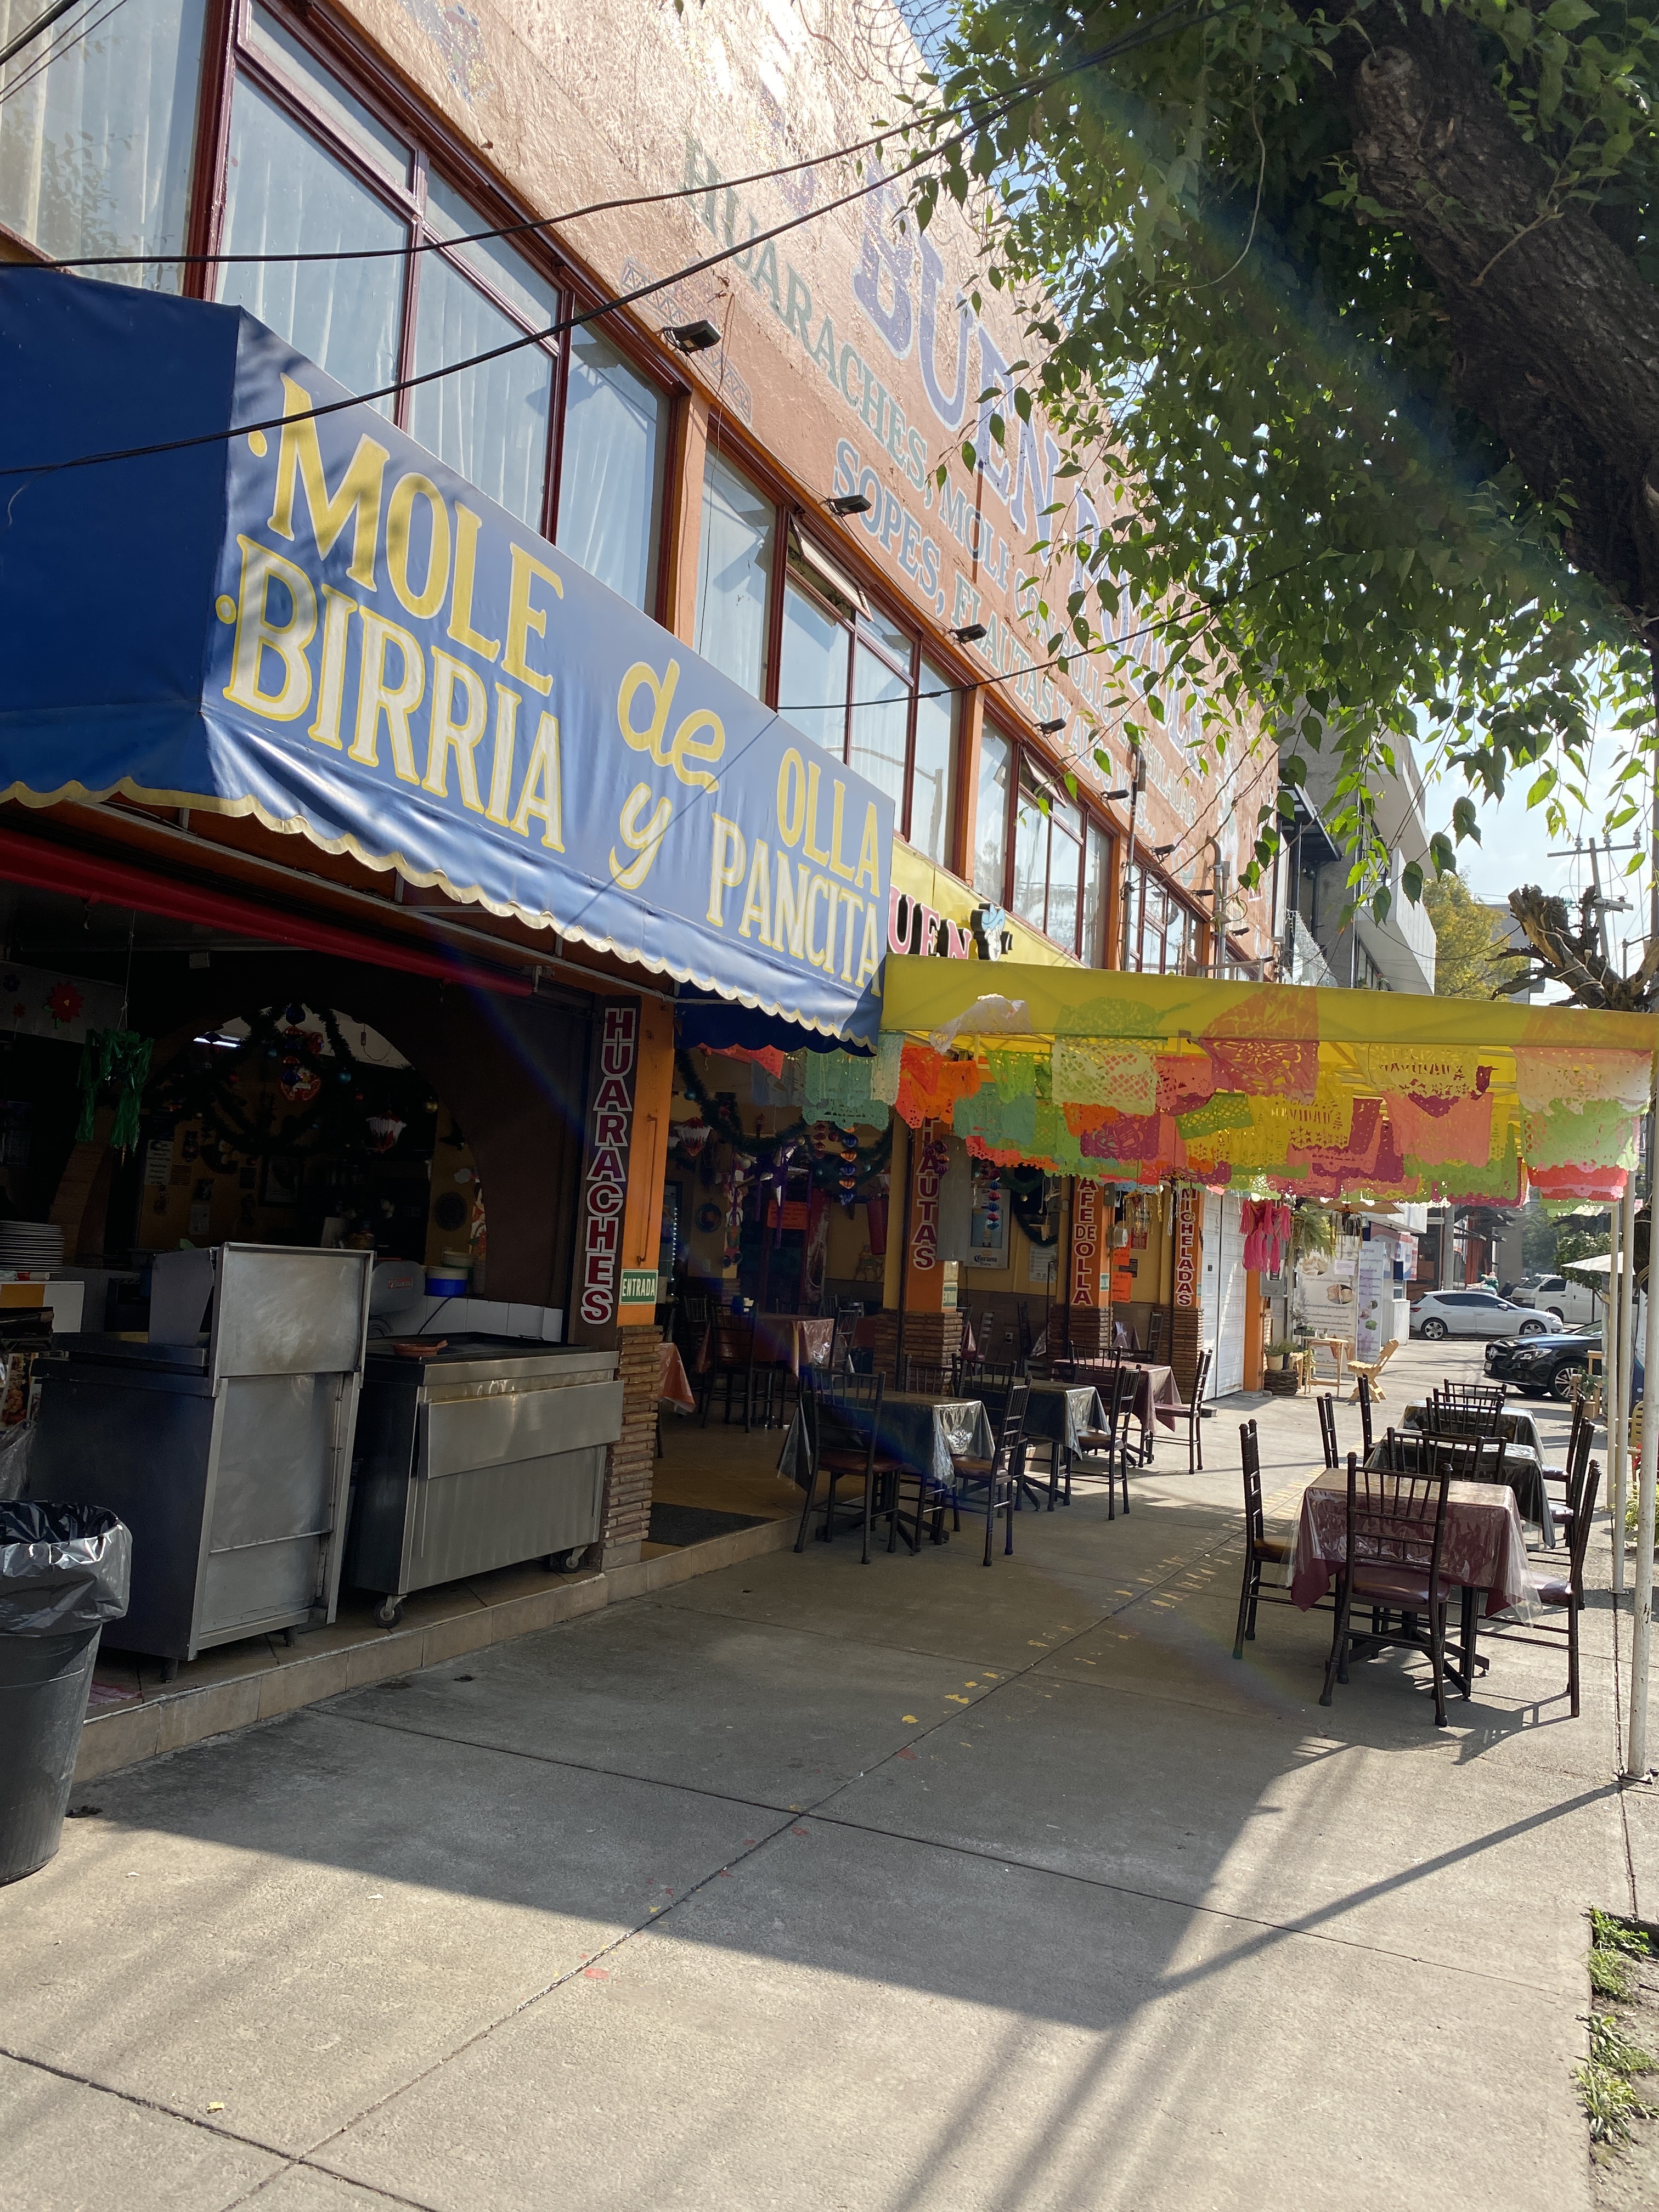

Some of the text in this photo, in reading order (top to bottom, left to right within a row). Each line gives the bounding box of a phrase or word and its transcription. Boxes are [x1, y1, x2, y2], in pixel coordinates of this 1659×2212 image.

[680, 128, 934, 510] HUARACHES,
[939, 474, 1009, 595] MOLE
[1014, 568, 1056, 648] CON
[1117, 704, 1197, 831] EHILADAS
[852, 144, 1061, 568] BUEN
[267, 372, 881, 898] MOLE de OLLA
[832, 437, 945, 618] SOPES,
[951, 569, 1058, 723] FLAUTAS
[1056, 690, 1071, 744] Y
[222, 534, 881, 997] BIRRIA y PANCITA
[580, 1008, 636, 1324] HUARACHES
[622, 1277, 656, 1298] ENTRADA
[1070, 1242, 1096, 1307] OLLA
[1074, 1224, 1097, 1242] DE
[1175, 1187, 1197, 1307] MICHELADAS
